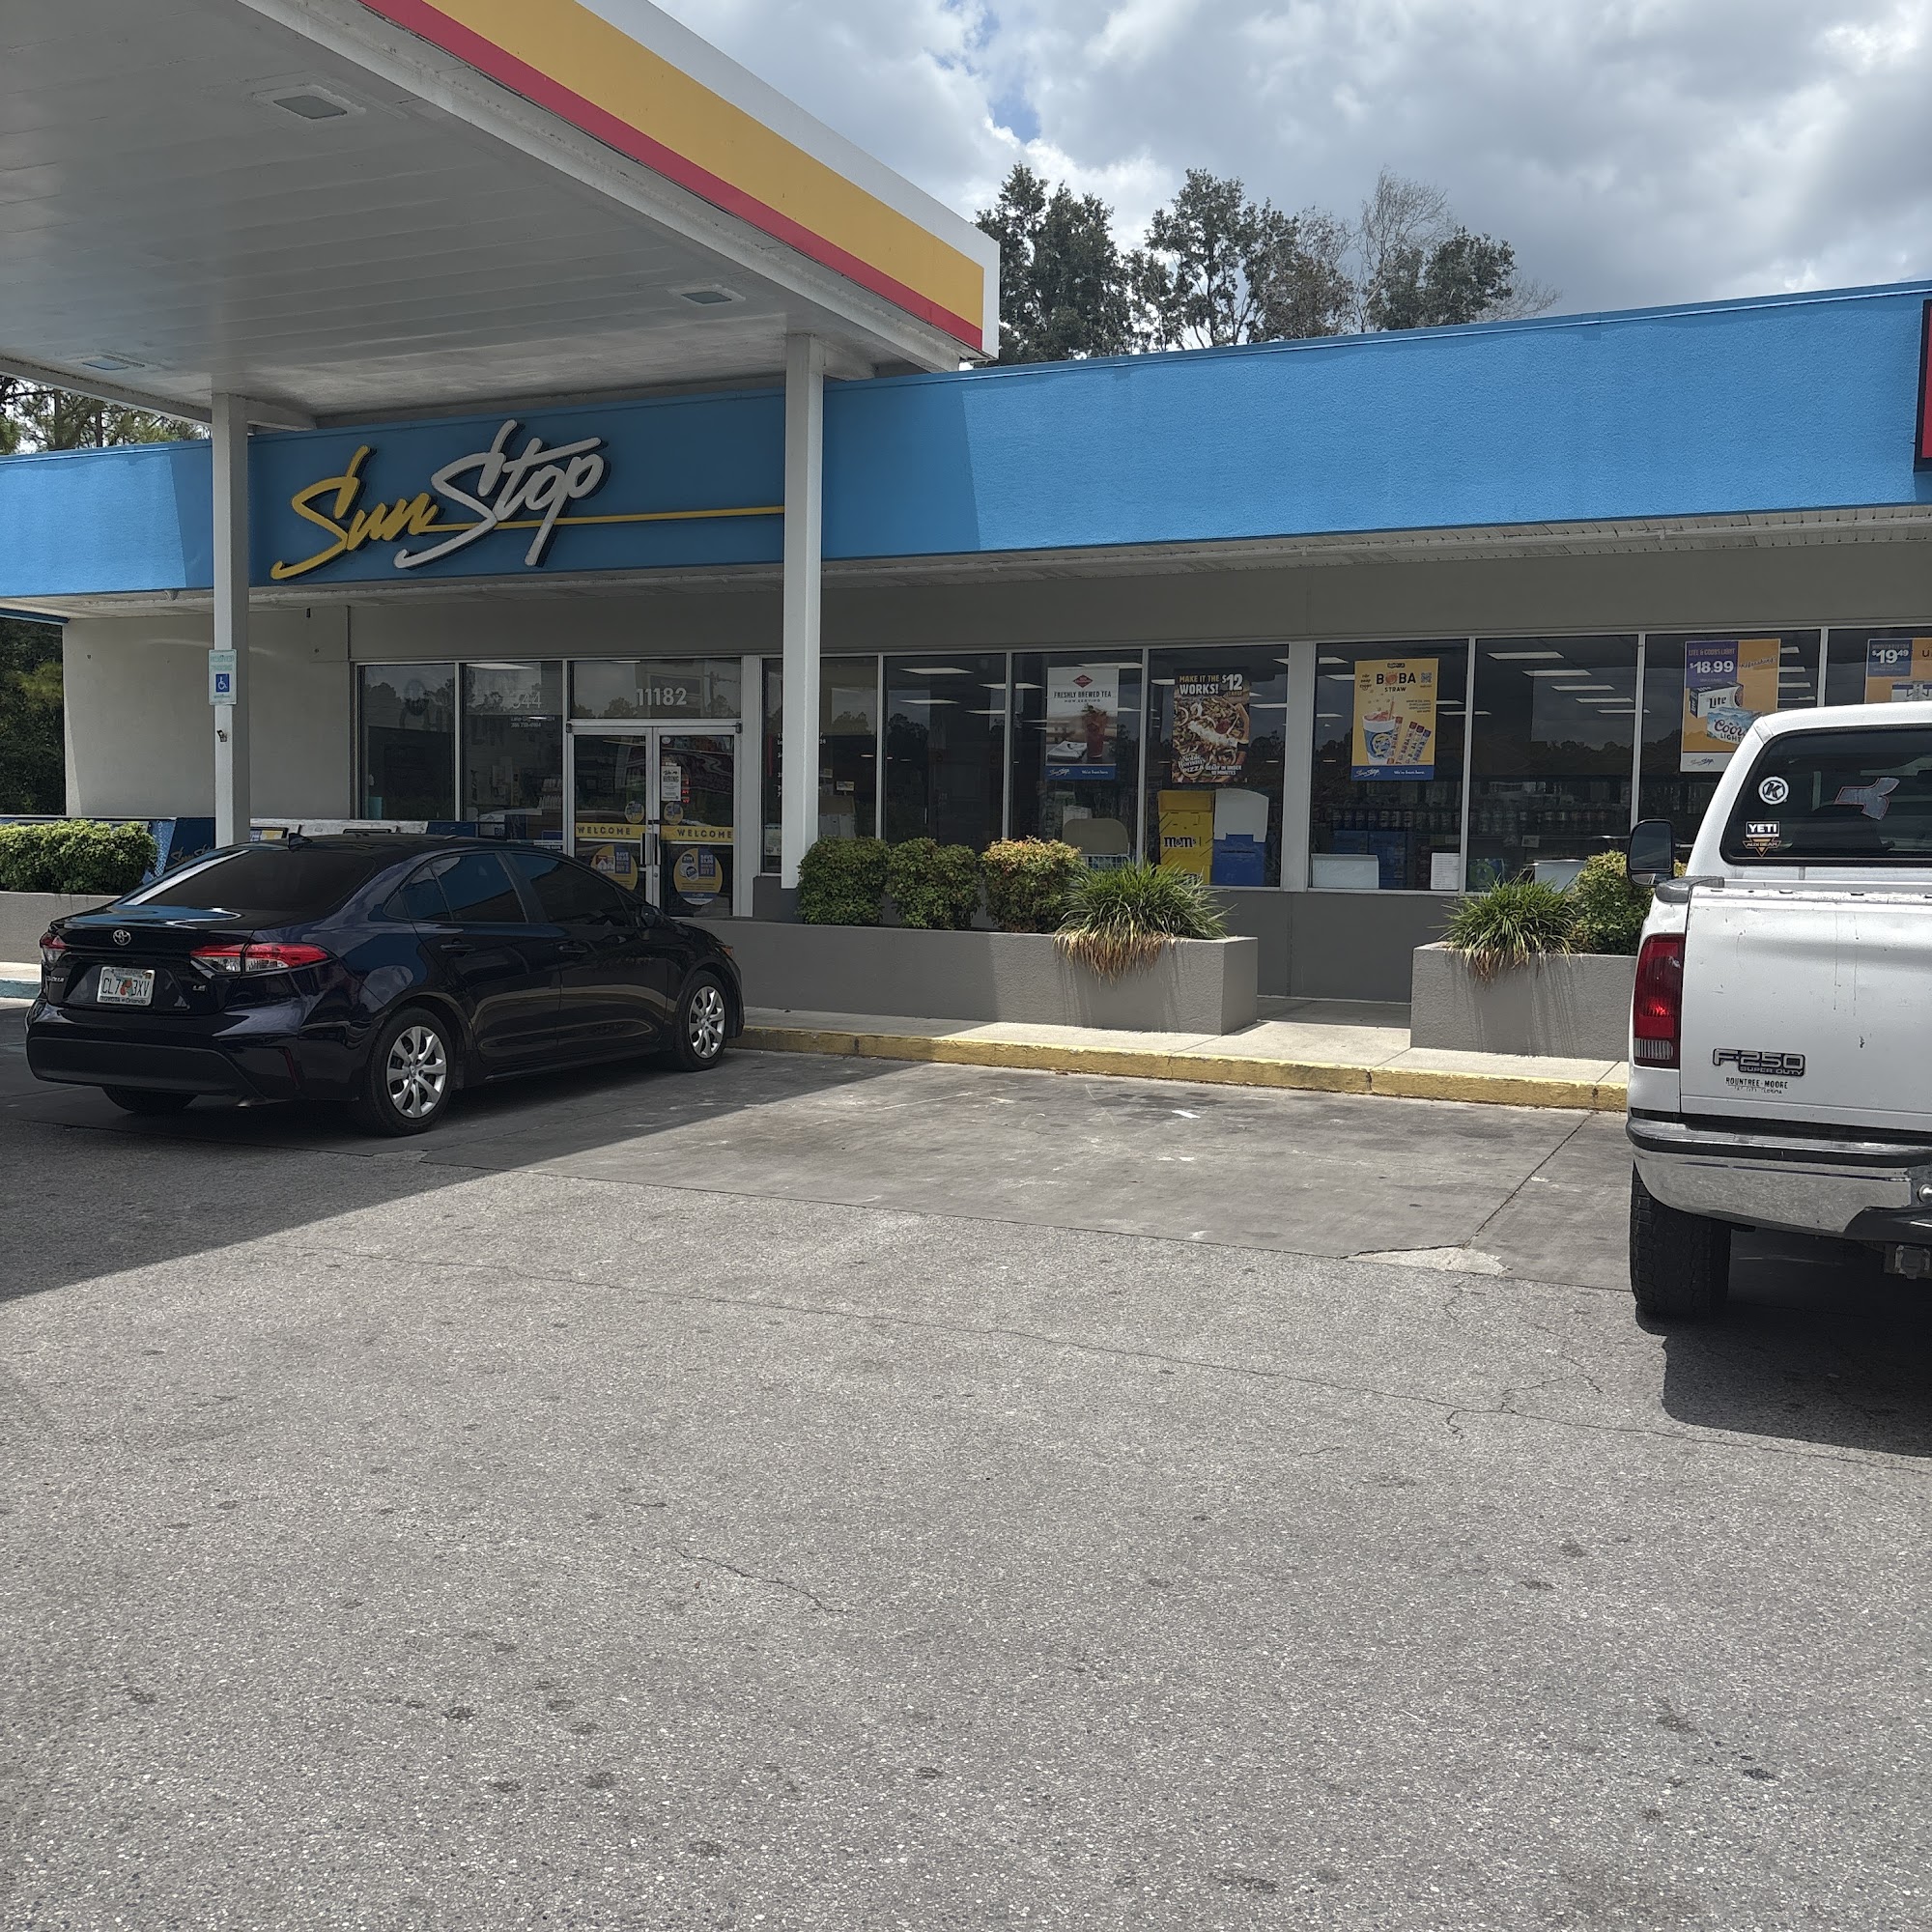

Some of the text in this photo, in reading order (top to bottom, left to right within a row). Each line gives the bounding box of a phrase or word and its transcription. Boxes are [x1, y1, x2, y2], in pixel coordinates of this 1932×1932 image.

[1690, 660, 1734, 674] $18.99
[1222, 673, 1243, 691] $12
[1179, 683, 1219, 695] WORKS!
[637, 687, 688, 706] 11182
[1709, 696, 1727, 709] Lite
[577, 826, 631, 836] WELCOME
[676, 829, 733, 839] WELCOME
[1748, 823, 1777, 834] YETI
